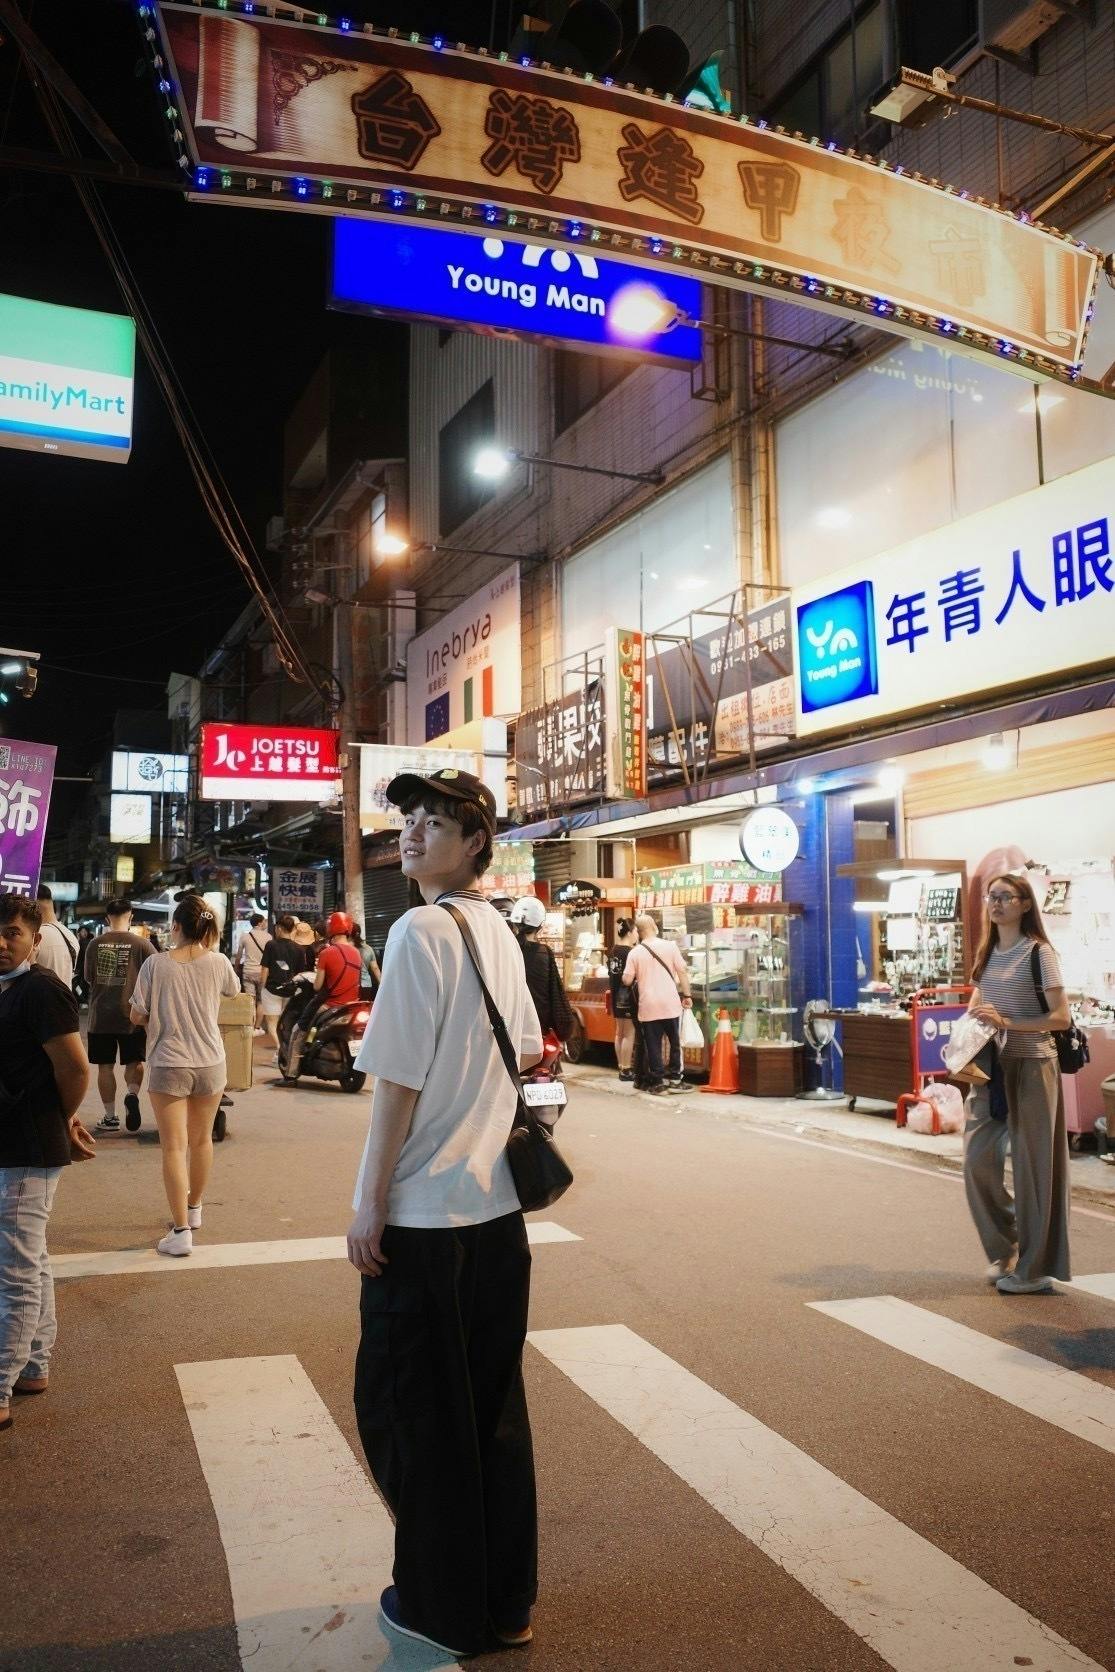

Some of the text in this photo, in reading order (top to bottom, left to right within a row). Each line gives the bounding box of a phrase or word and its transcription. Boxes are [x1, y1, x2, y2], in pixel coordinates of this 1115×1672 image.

[351, 70, 987, 307] 台灣逢甲夜市
[447, 264, 605, 316] Young Man
[886, 517, 1114, 653] 年青人眼
[426, 613, 491, 678] Inebrya
[807, 656, 861, 683] Young Man
[251, 738, 319, 755] JOETSU
